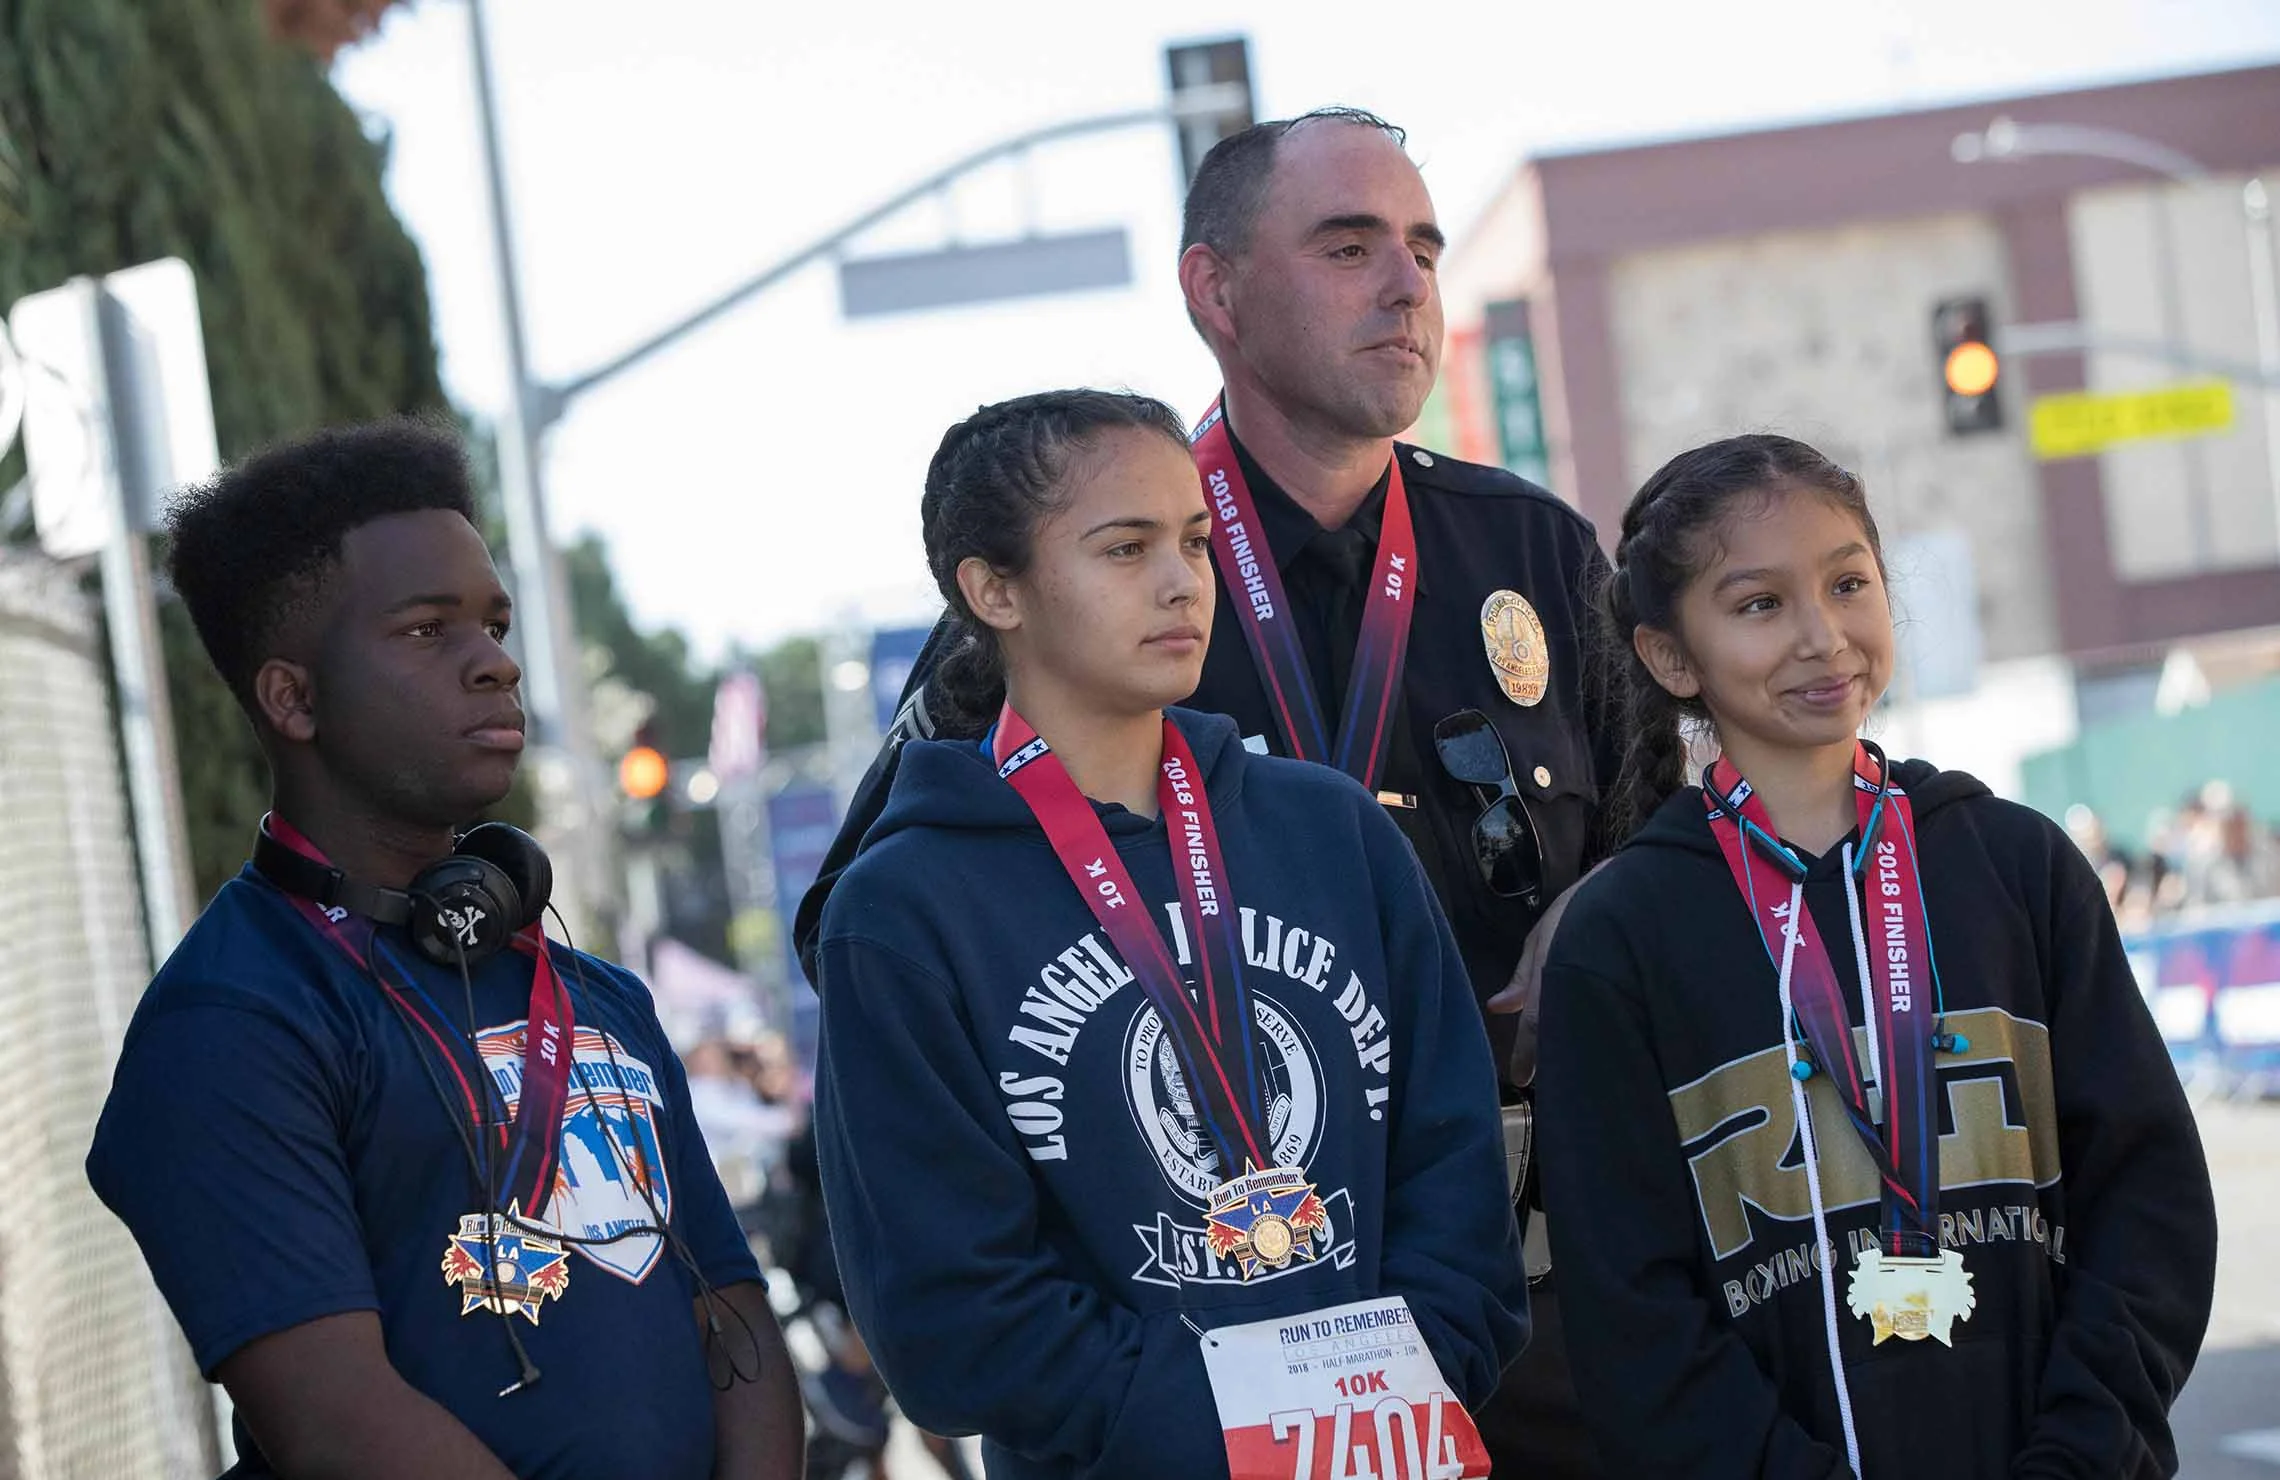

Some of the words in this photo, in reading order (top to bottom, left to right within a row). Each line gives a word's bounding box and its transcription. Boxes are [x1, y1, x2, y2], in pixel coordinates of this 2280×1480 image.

[1208, 469, 1238, 522] 2018
[1226, 521, 1274, 622] FINISHER
[1163, 757, 1195, 805] 2018
[1182, 810, 1219, 916] FINISHER
[1877, 841, 1901, 896] 2018
[1165, 902, 1335, 993] LICE
[1883, 902, 1911, 1013] FINISHER
[1008, 926, 1137, 1066] ANGEL
[1256, 1007, 1299, 1057] SERVE
[568, 1062, 652, 1097] member
[1135, 1050, 1149, 1073] TO
[999, 1071, 1067, 1161] LOS
[1213, 1190, 1232, 1207] Run
[1231, 1183, 1245, 1197] To
[1245, 1173, 1299, 1192] Remember
[1250, 1200, 1273, 1215] LA
[497, 1244, 520, 1260] LA
[1279, 1323, 1311, 1345] RUN
[1311, 1320, 1332, 1339] TO
[1334, 1306, 1414, 1334] REMEMBER
[1287, 1362, 1309, 1375] 2018
[1334, 1369, 1390, 1398] 10K
[1269, 1391, 1465, 1480] 7404
